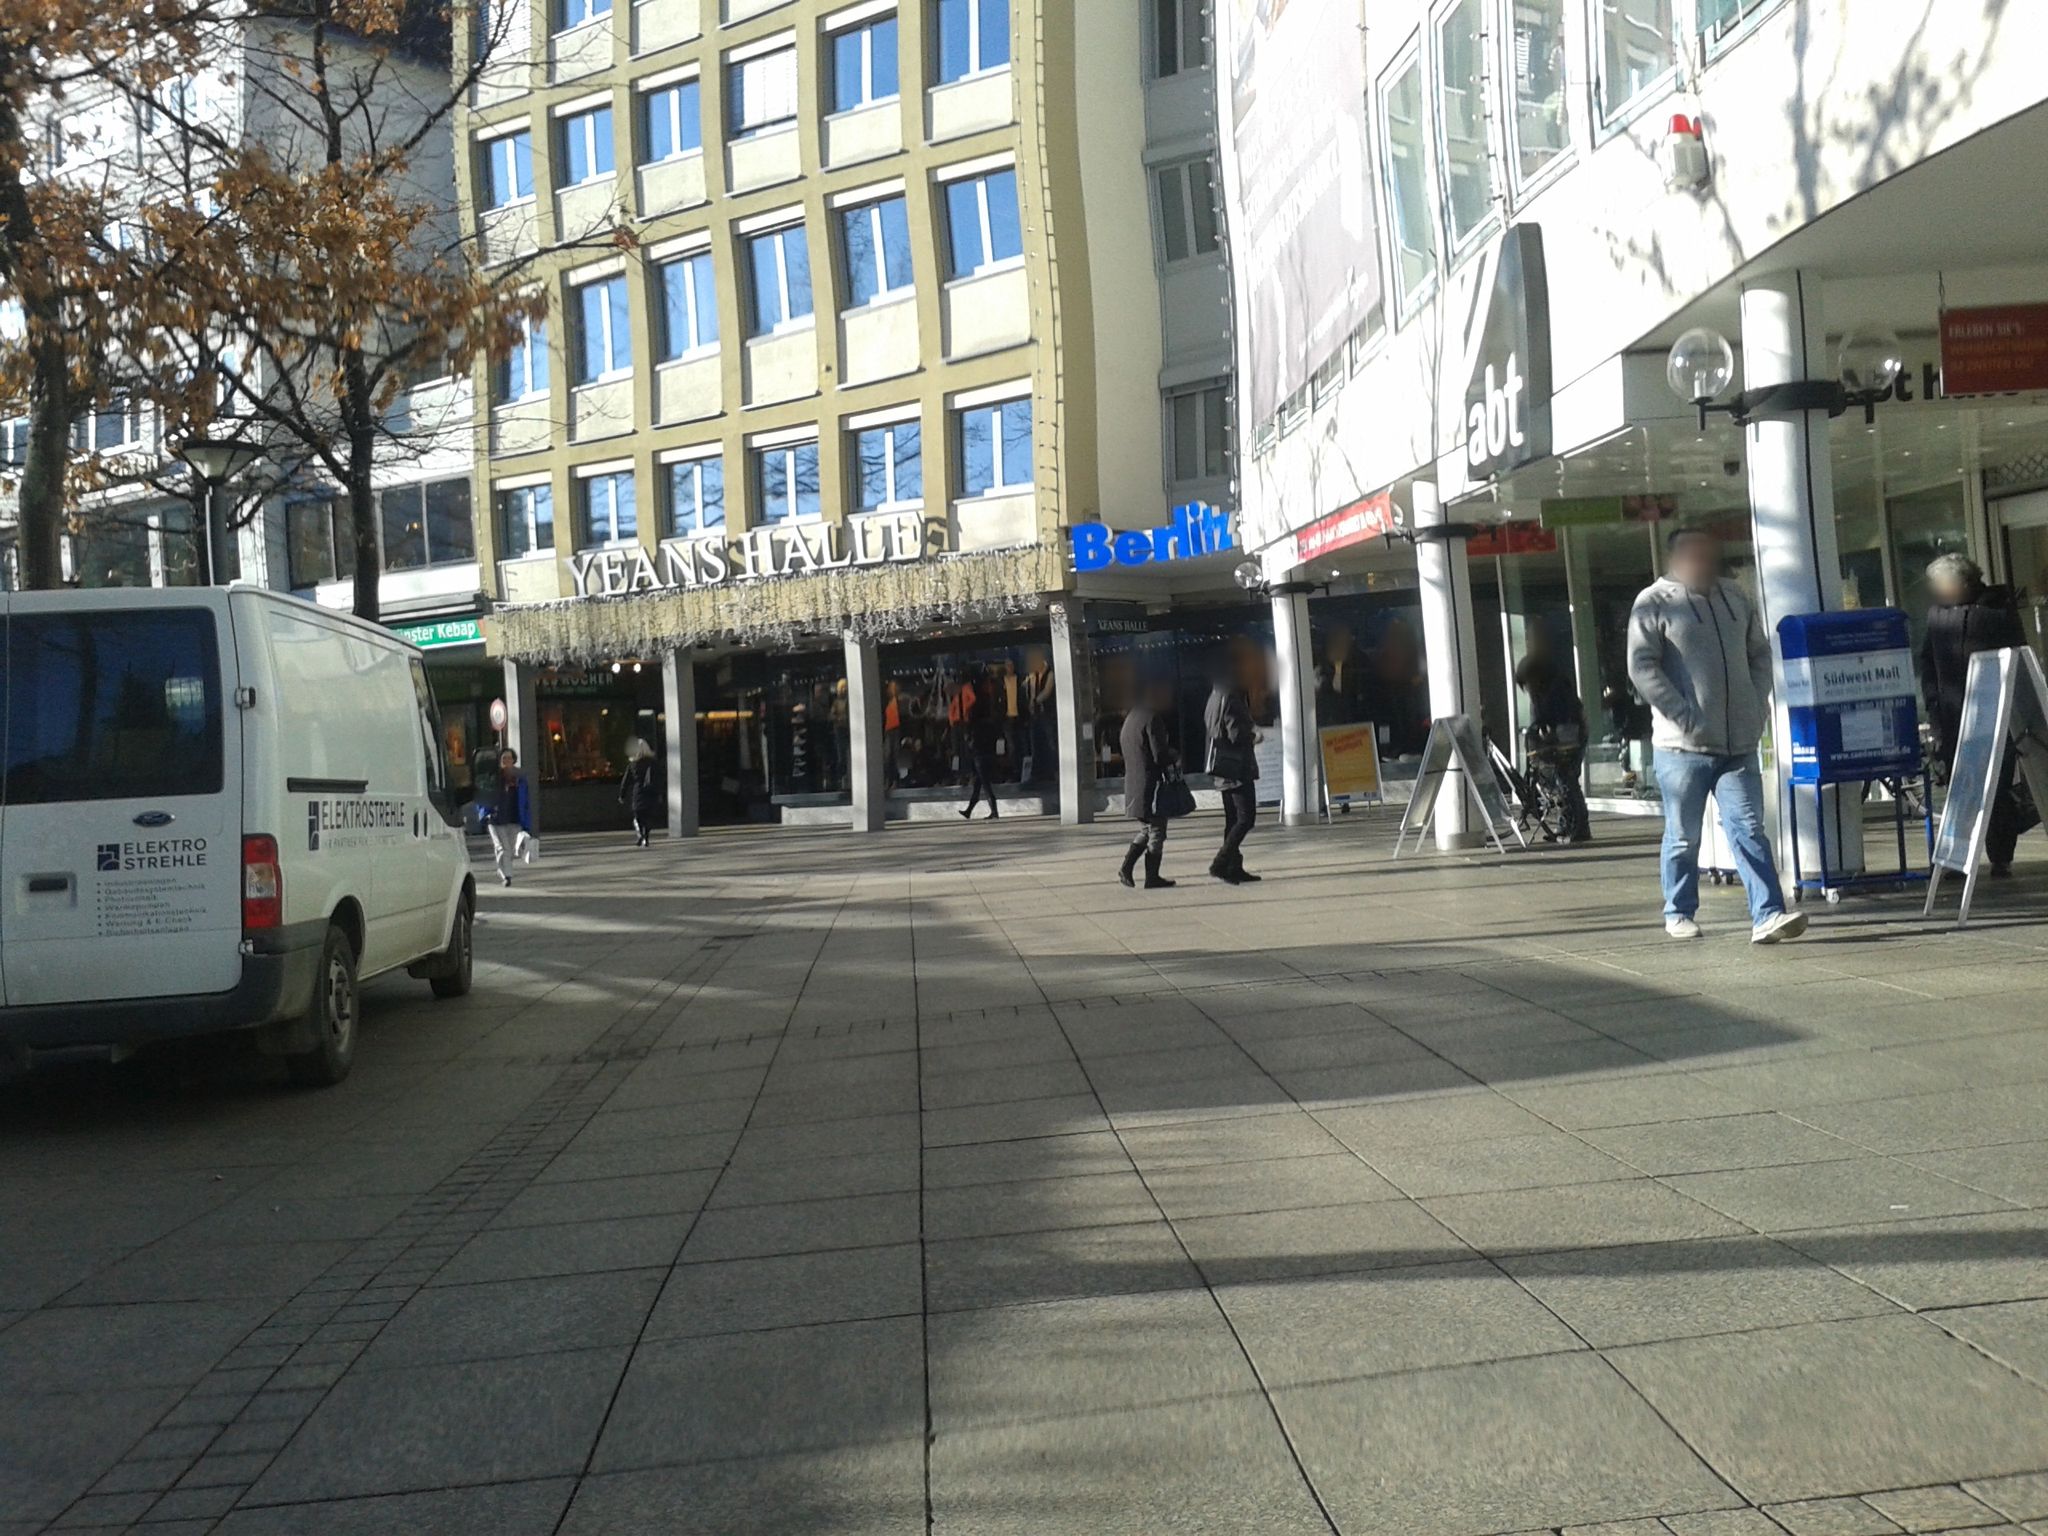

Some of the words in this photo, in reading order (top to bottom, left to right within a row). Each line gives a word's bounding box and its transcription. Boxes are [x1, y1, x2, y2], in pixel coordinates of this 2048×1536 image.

[1468, 352, 1524, 466] abt
[1070, 500, 1236, 573] Berlitz
[563, 534, 727, 598] YEANS
[736, 511, 925, 581] HALLE
[437, 621, 476, 639] Kebap
[1823, 669, 1872, 687] Südwest
[1875, 666, 1900, 681] Mail
[124, 838, 207, 855] ELEKTRO
[124, 853, 207, 870] STREHLE
